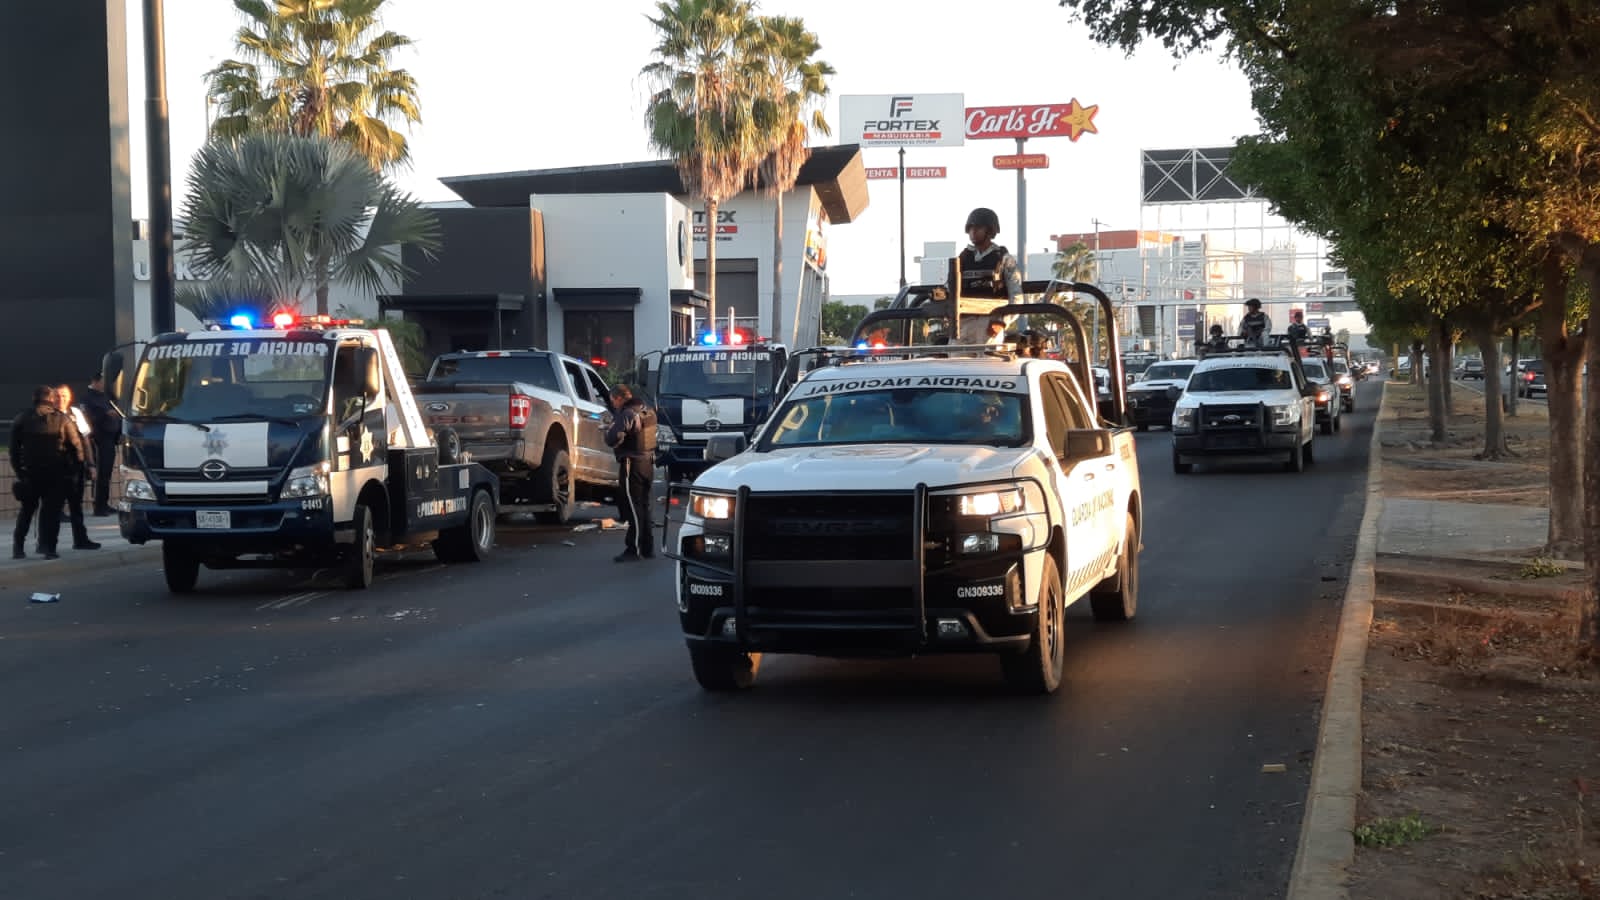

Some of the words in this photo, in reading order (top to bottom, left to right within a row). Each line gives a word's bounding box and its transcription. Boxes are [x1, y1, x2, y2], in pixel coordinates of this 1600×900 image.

[864, 120, 940, 131] FORTEX
[965, 107, 1027, 135] Carl's
[1028, 107, 1060, 133] Jr.
[910, 169, 942, 177] RENTA
